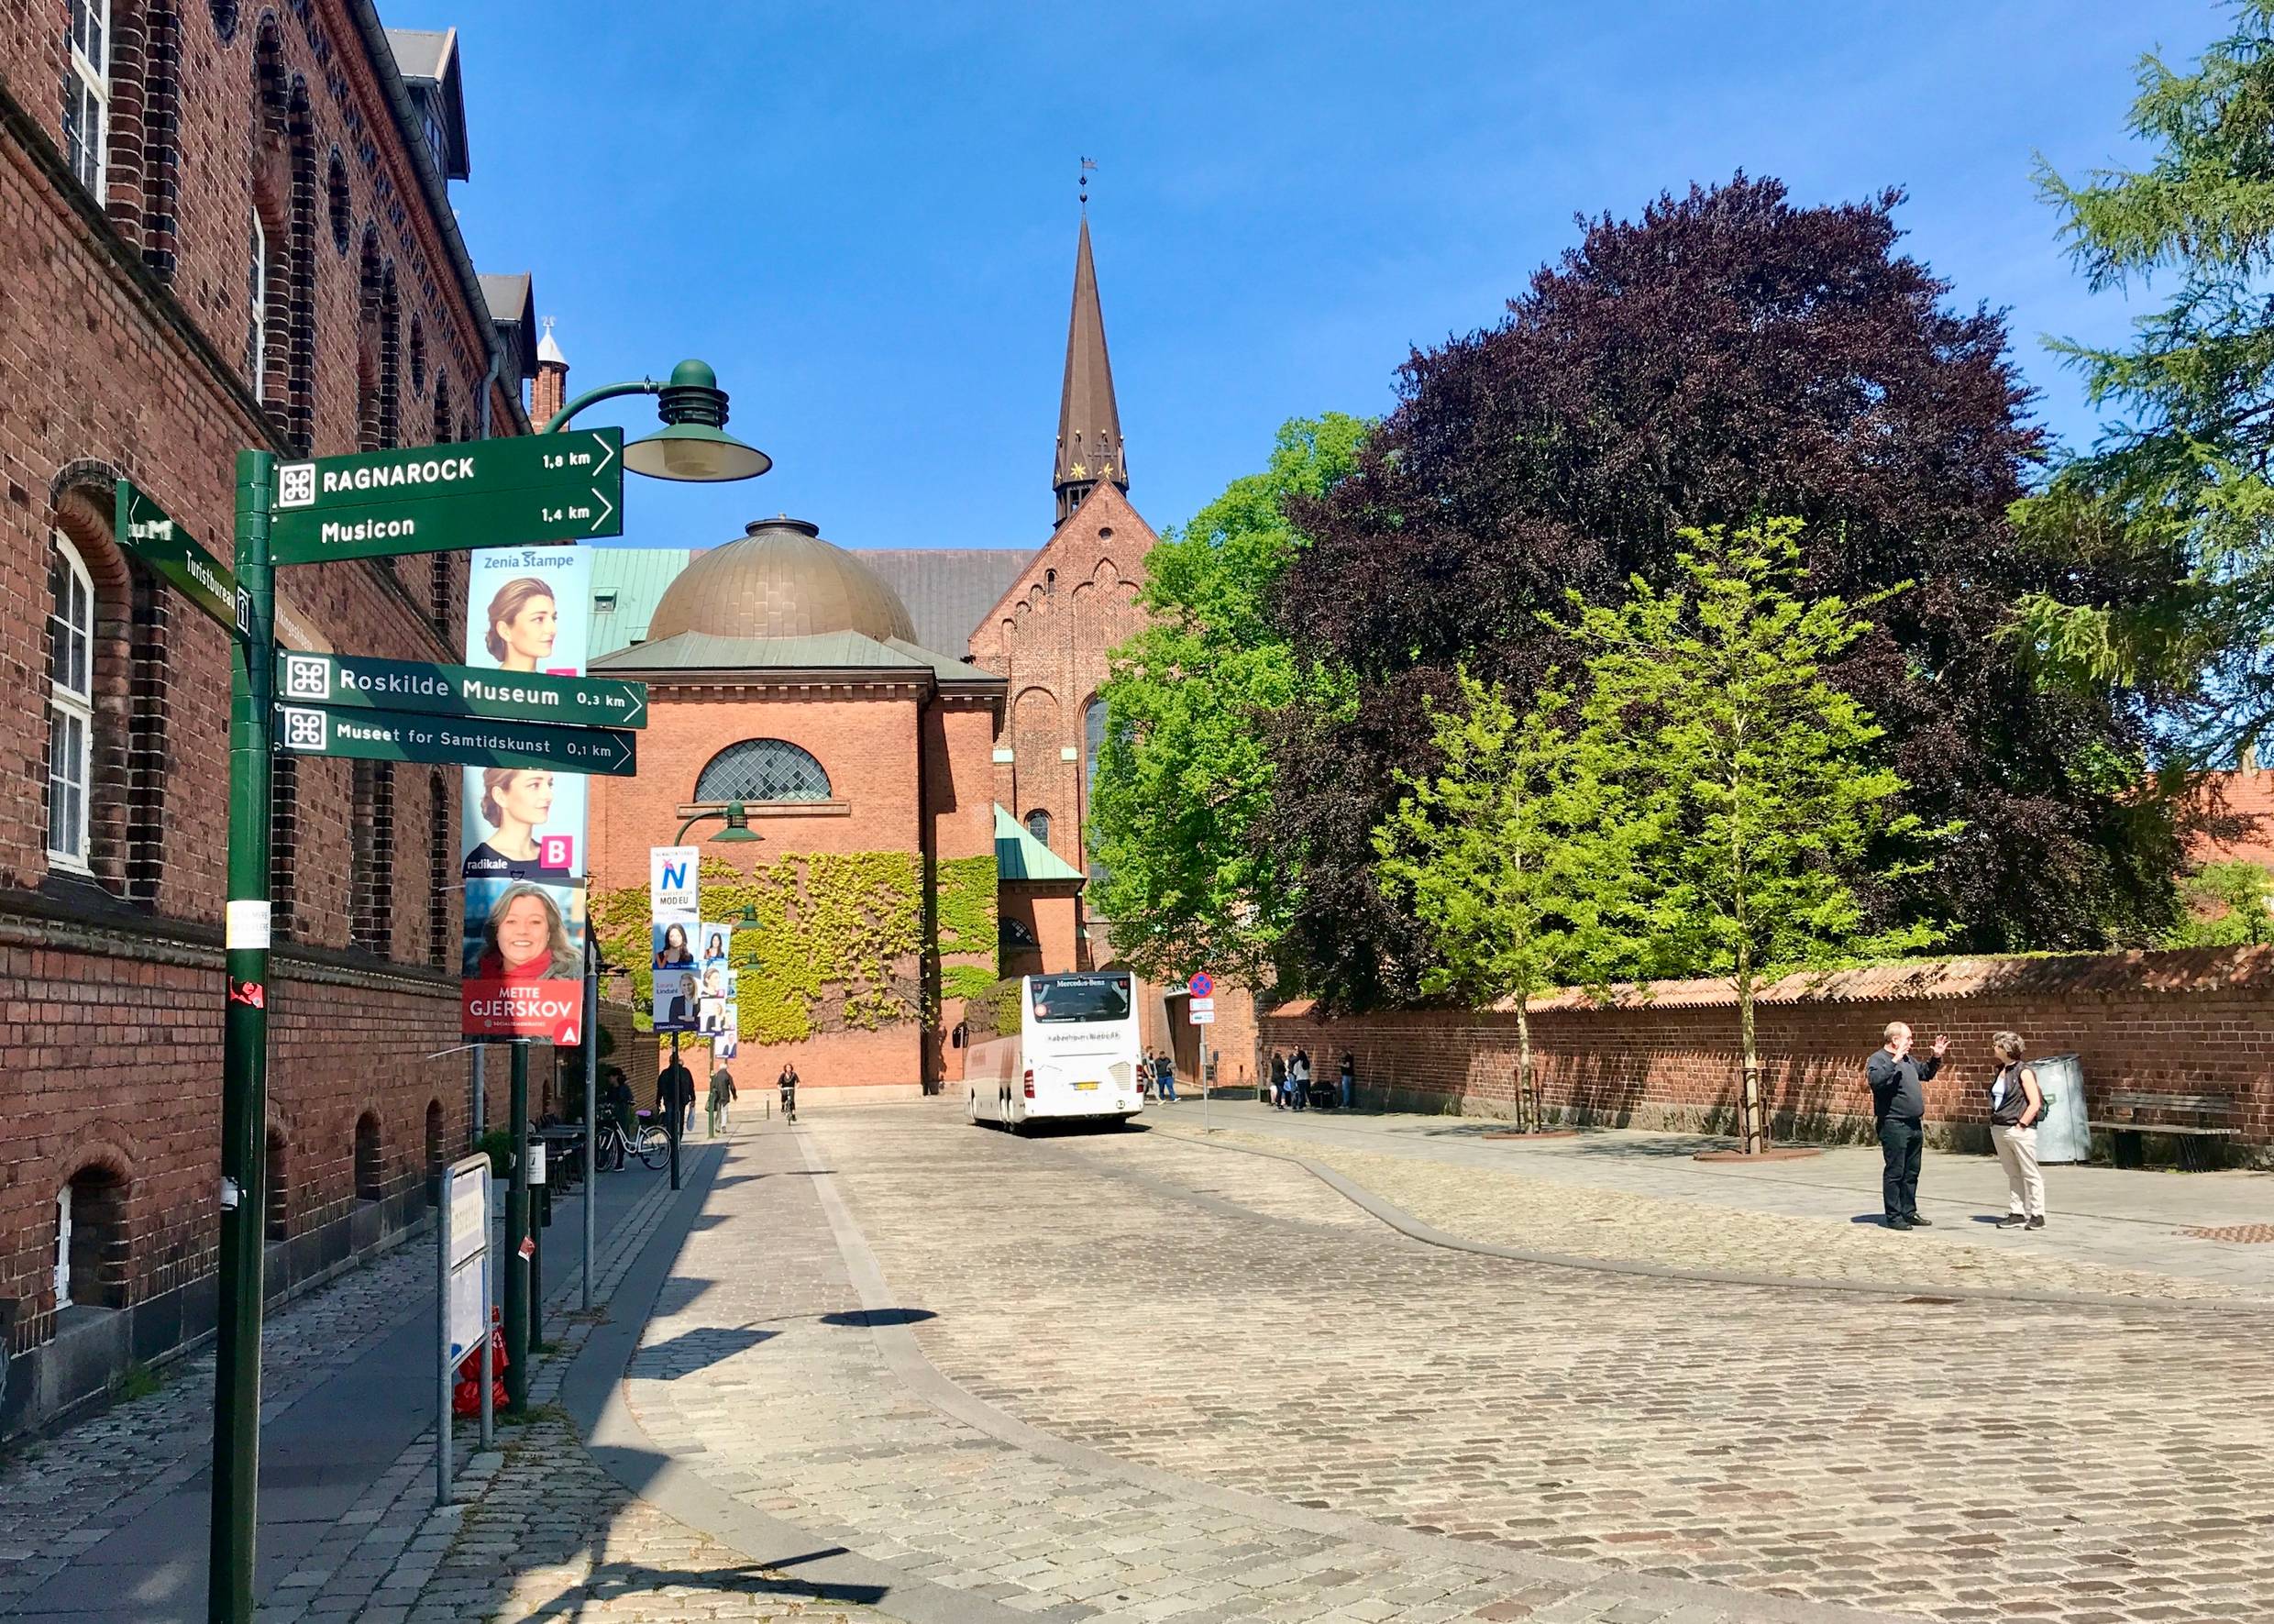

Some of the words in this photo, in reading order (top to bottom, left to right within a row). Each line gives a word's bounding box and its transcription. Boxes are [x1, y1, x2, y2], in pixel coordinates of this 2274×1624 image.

[569, 452, 591, 466] km
[323, 458, 474, 492] RAGNAROCK
[568, 506, 590, 520] km
[322, 519, 414, 544] Musicon
[484, 555, 520, 569] Zenia
[523, 556, 574, 569] Stampe
[186, 550, 236, 610] Turistbureau
[340, 668, 449, 697] Roskilde
[463, 679, 559, 706] Museum
[577, 692, 600, 705] 0,3
[606, 695, 625, 707] km
[337, 724, 401, 742] Museet
[408, 730, 434, 744] for
[440, 733, 551, 753] Samtidskunst
[567, 743, 587, 756] 0,1
[592, 745, 612, 757] km
[548, 841, 566, 863] B
[468, 859, 508, 869] radikale
[662, 862, 687, 889] N
[660, 897, 678, 905] MOD
[679, 896, 689, 904] EU
[1056, 979, 1106, 988] Mercedes-Benz
[499, 987, 540, 999] METTE
[469, 1000, 572, 1018] GJERSKOV
[561, 1026, 577, 1043] A
